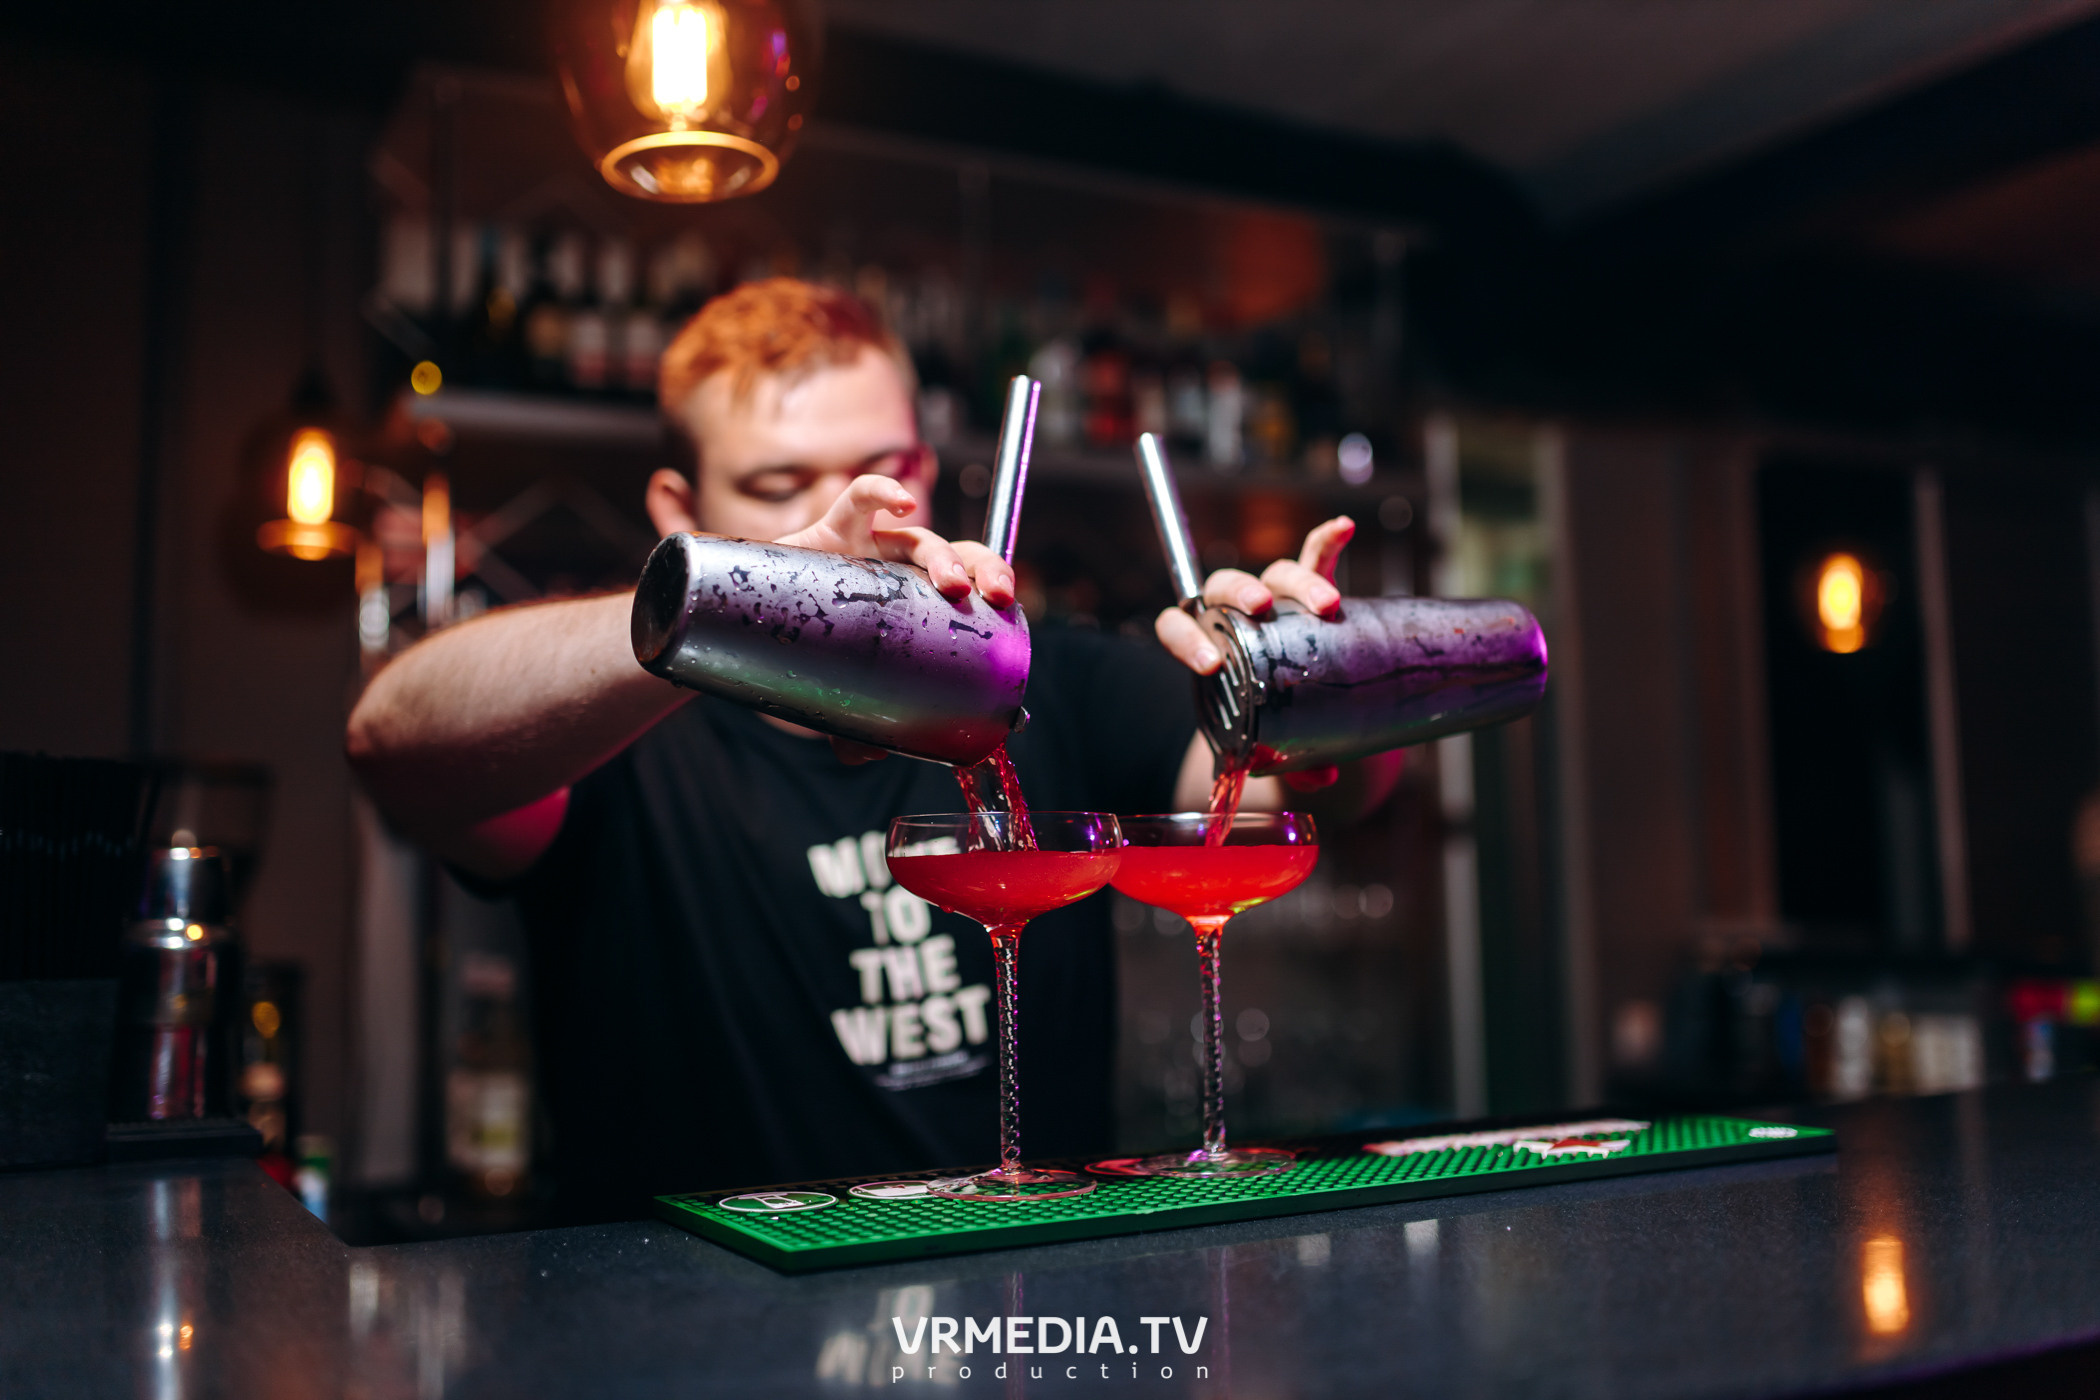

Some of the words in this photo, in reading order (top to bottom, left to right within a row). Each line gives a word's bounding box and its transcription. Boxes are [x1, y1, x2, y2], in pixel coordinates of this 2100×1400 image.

[807, 830, 961, 898] MO
[860, 884, 931, 945] TO
[849, 934, 962, 1005] THE
[830, 984, 991, 1066] WEST
